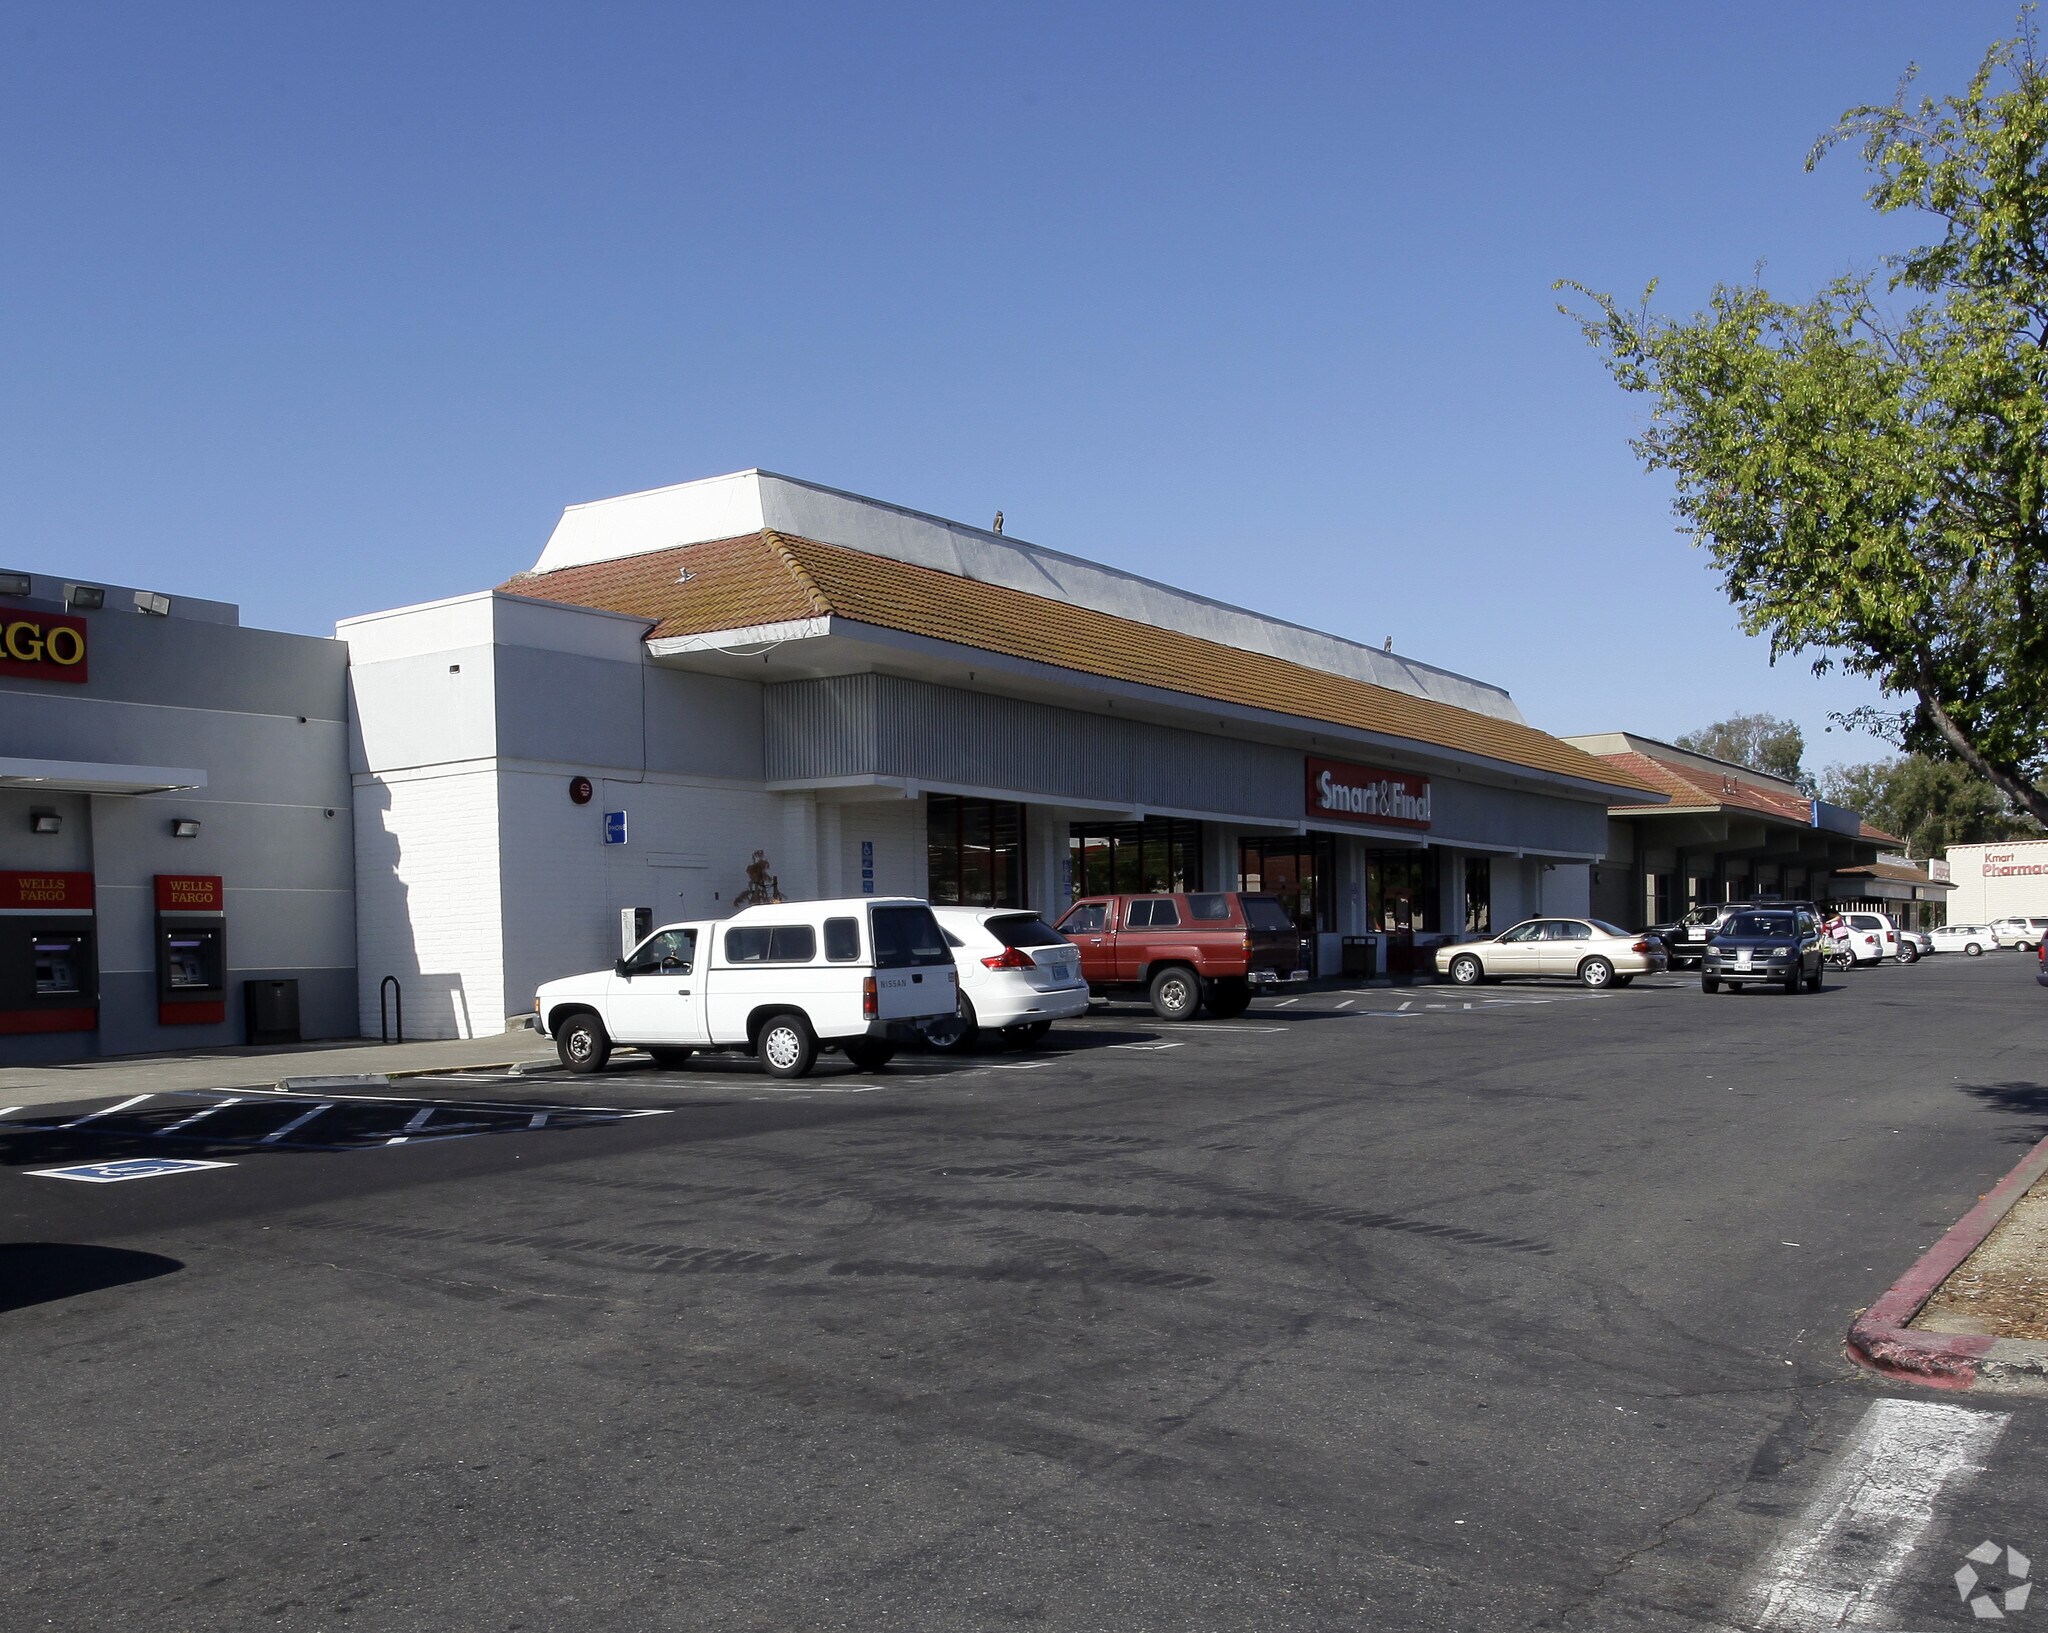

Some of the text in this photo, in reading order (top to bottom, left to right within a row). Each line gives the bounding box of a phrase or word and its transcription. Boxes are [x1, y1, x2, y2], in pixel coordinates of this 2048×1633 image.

[0, 621, 85, 665] GO
[1984, 853, 2015, 863] Kmart
[18, 878, 65, 889] WELLS
[170, 880, 213, 891] WELLS
[20, 890, 65, 901] FARGO
[171, 892, 213, 903] FARGO
[881, 980, 907, 988] NISSAN
